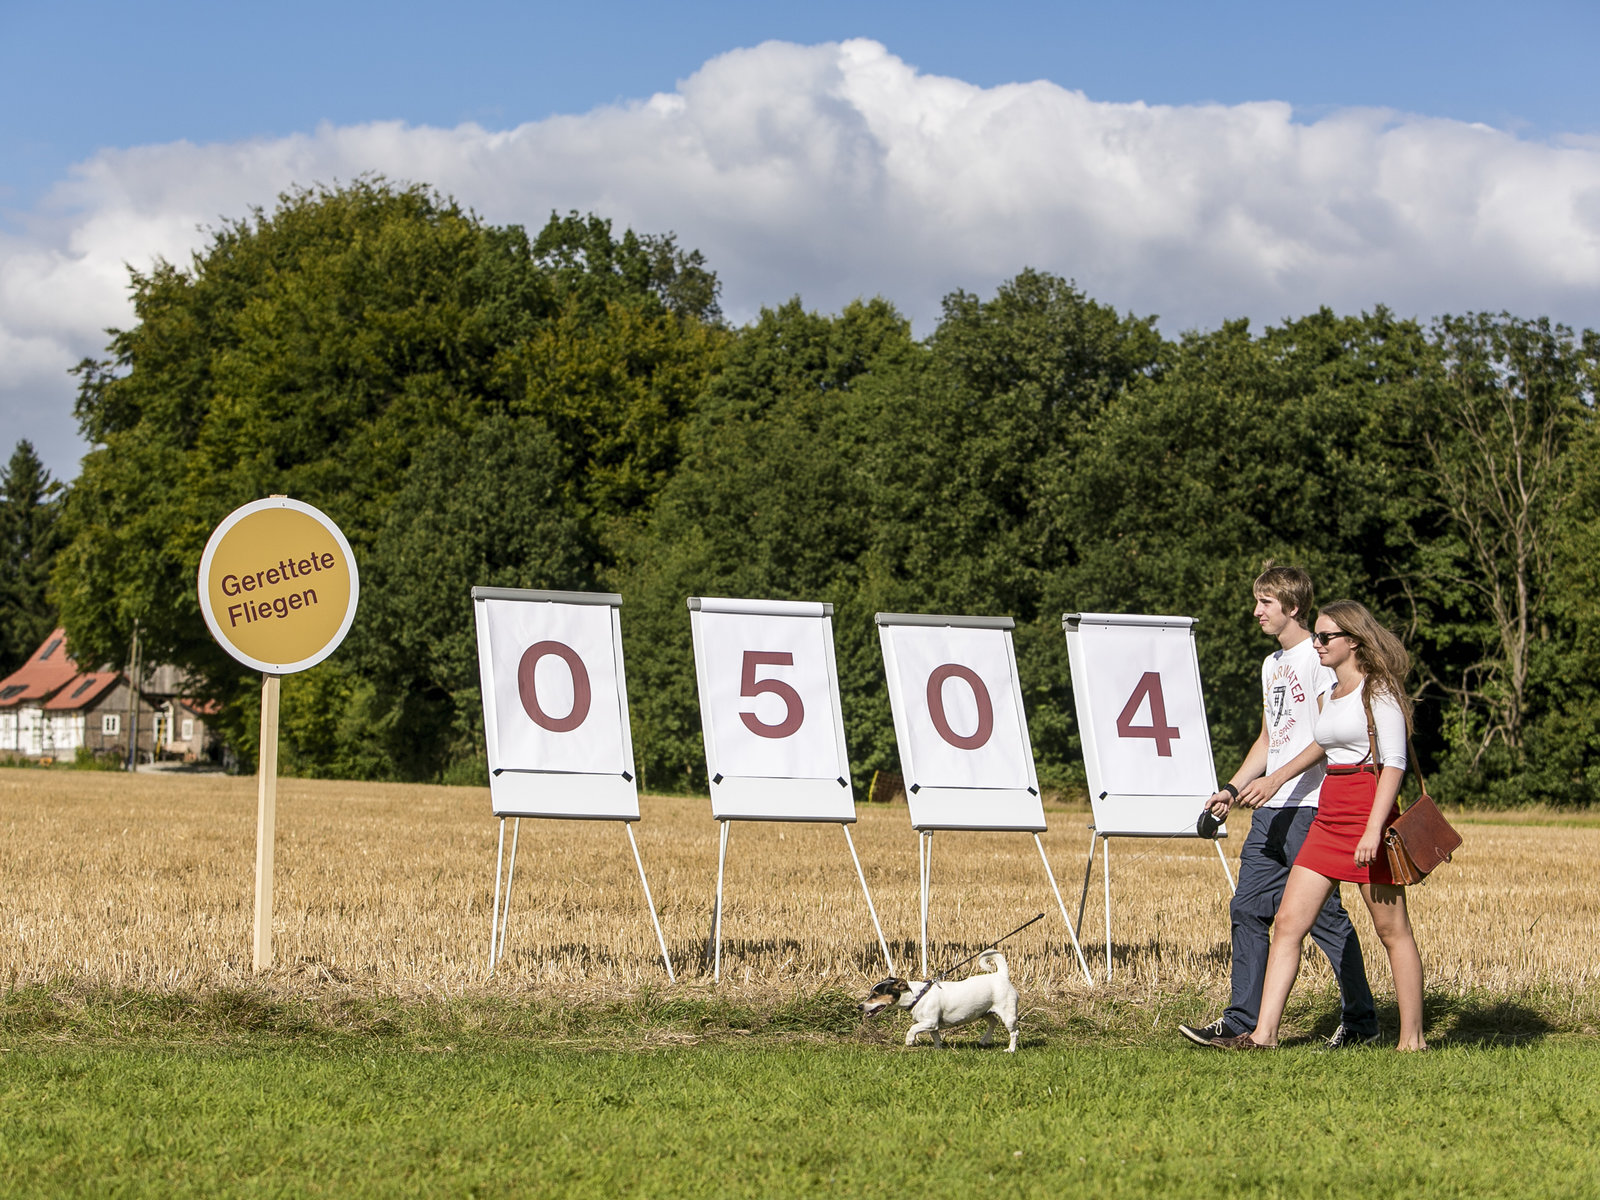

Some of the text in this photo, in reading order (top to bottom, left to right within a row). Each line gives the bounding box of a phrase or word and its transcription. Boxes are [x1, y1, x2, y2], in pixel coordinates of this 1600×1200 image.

[221, 551, 335, 597] Gerettete
[228, 588, 318, 627] Fliegen
[517, 640, 1181, 757] 0 5 0 4
